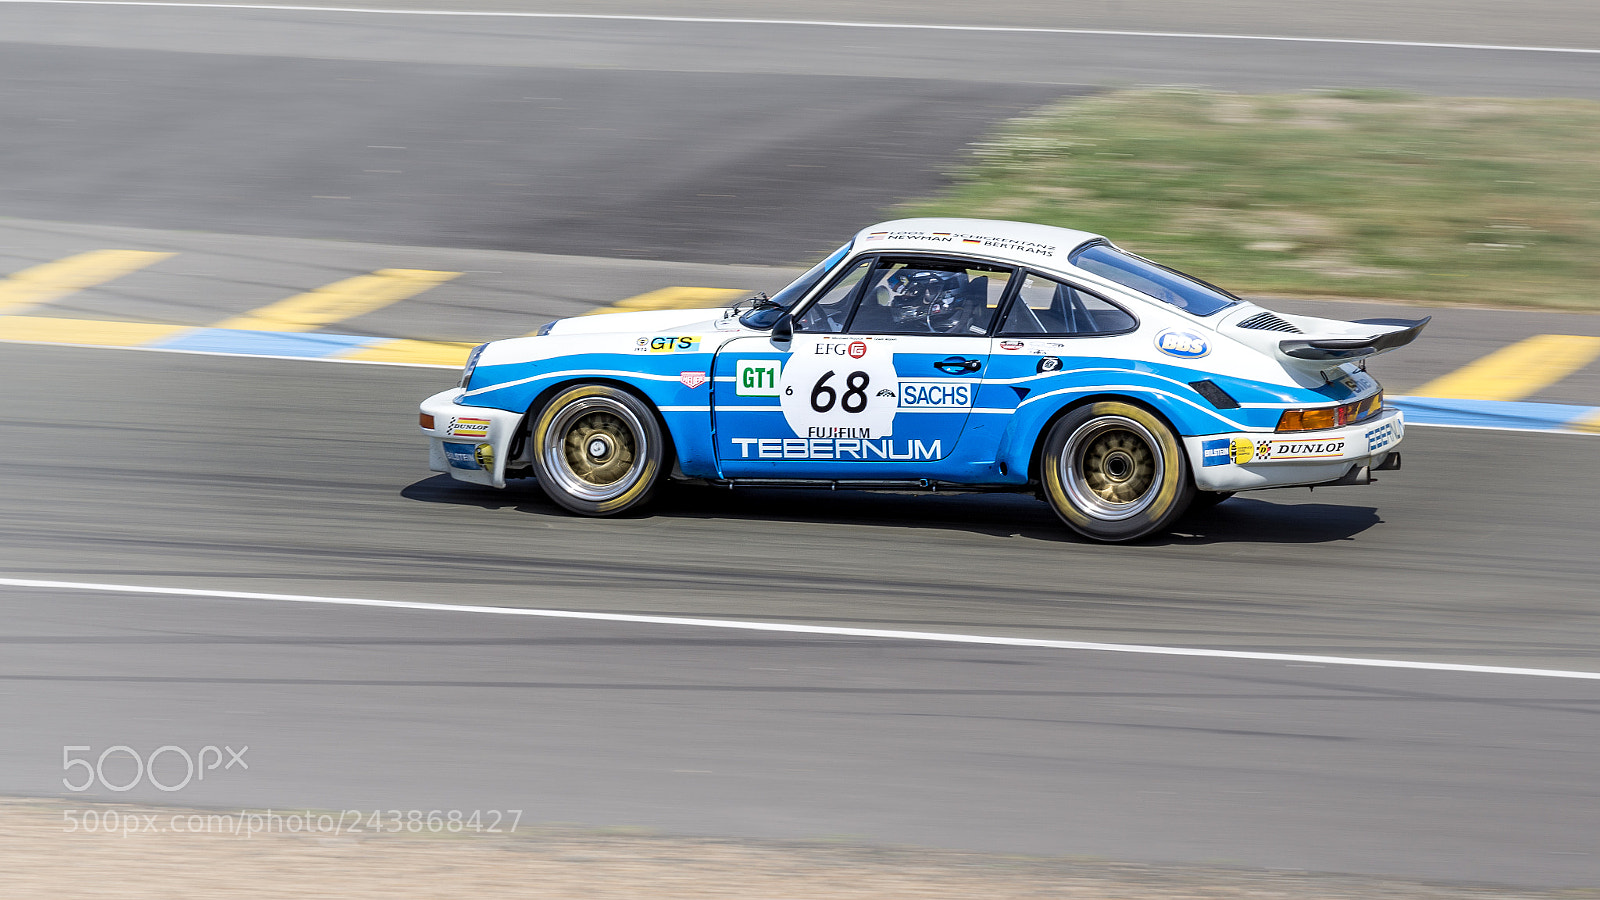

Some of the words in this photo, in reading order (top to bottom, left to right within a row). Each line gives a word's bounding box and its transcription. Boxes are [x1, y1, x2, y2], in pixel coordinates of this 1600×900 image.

[887, 234, 953, 243] NEWMAN
[983, 240, 1054, 258] BERTRAMS
[953, 232, 1057, 251] SCHICKENTANZ
[650, 336, 693, 350] GTS
[814, 343, 846, 356] EFG
[1161, 333, 1207, 354] BBS
[742, 366, 775, 389] GT1
[785, 385, 794, 396] 6
[810, 369, 870, 414] 68
[904, 385, 969, 406] SACHS
[453, 422, 489, 431] DUNLOP
[808, 426, 871, 439] FUJIFILM
[731, 438, 942, 460] TEBERNUM
[1204, 447, 1229, 458] BILSTEIN
[1277, 442, 1345, 455] DUNLOP
